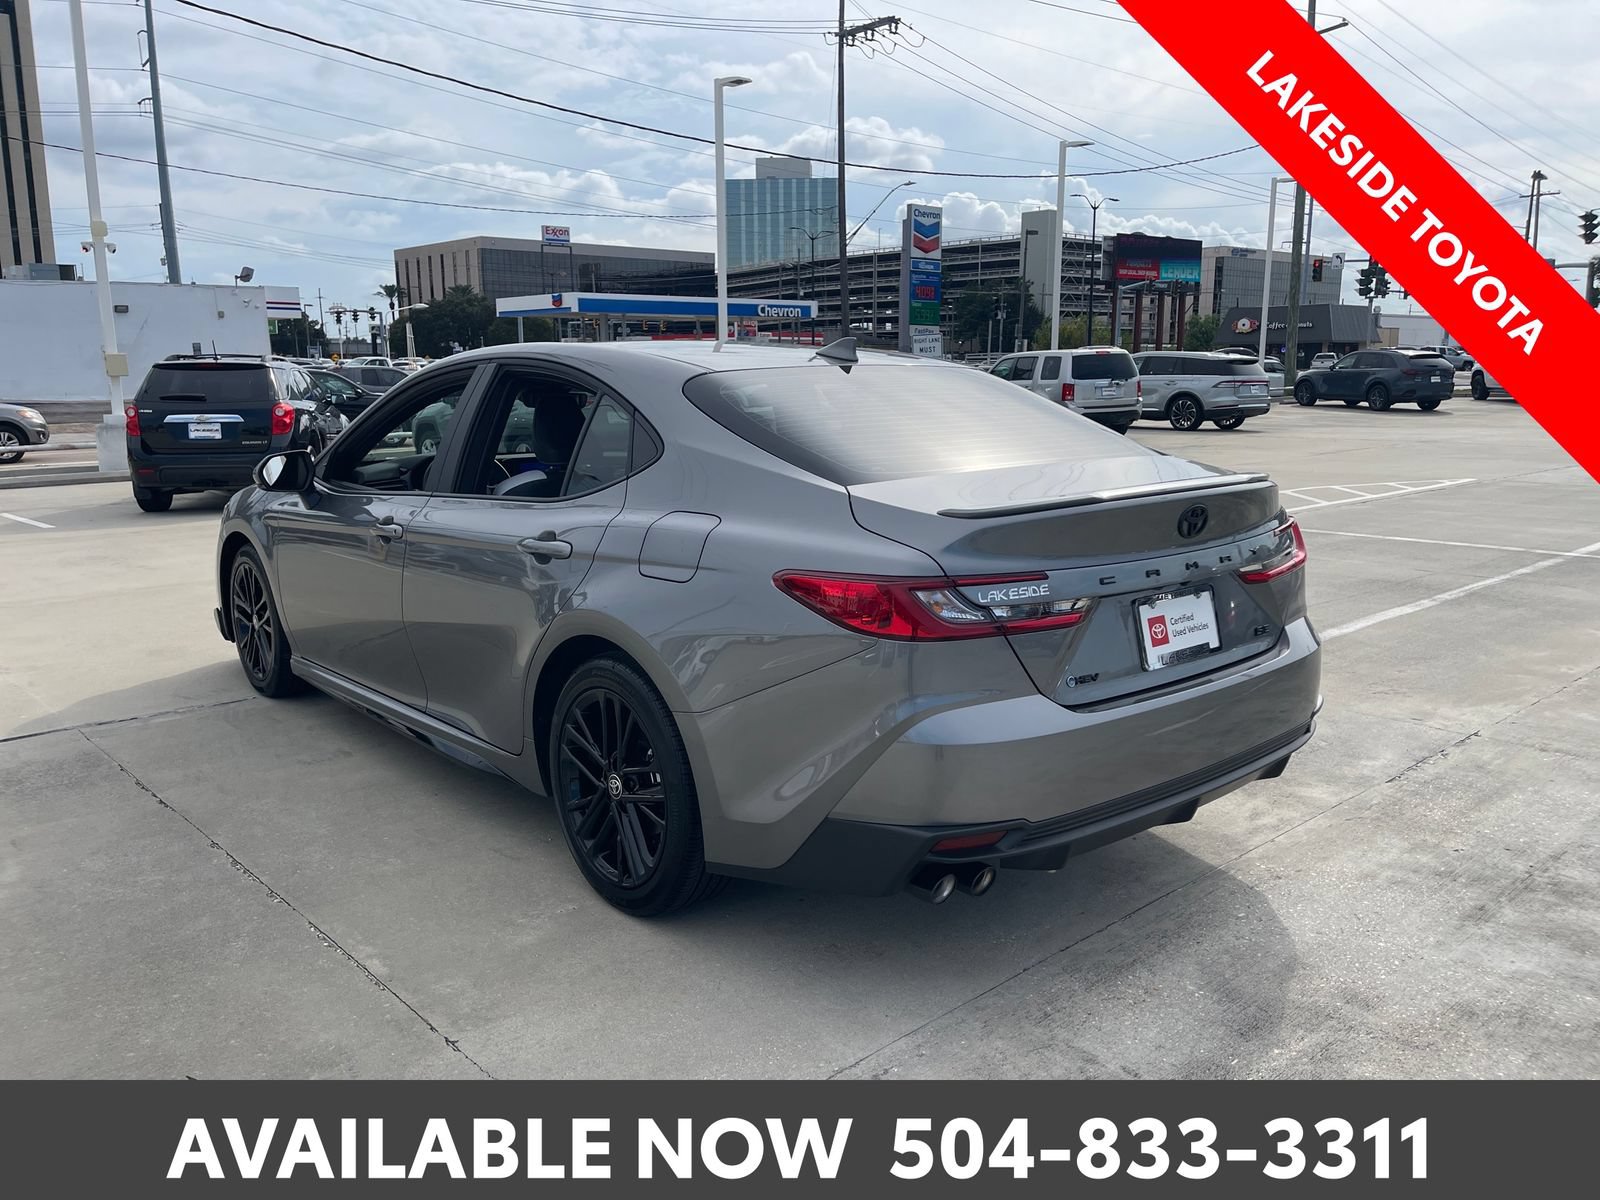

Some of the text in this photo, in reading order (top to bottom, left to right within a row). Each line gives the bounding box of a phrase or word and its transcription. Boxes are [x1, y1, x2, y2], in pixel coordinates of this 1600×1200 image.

[913, 208, 941, 219] Chevron
[545, 226, 569, 238] Exxon
[757, 304, 801, 317] Chevron
[1099, 547, 1260, 586] CAMRY
[978, 584, 1050, 602] LAKESIDE
[1169, 612, 1194, 626] Certified
[1172, 622, 1209, 637] Used Vehicles
